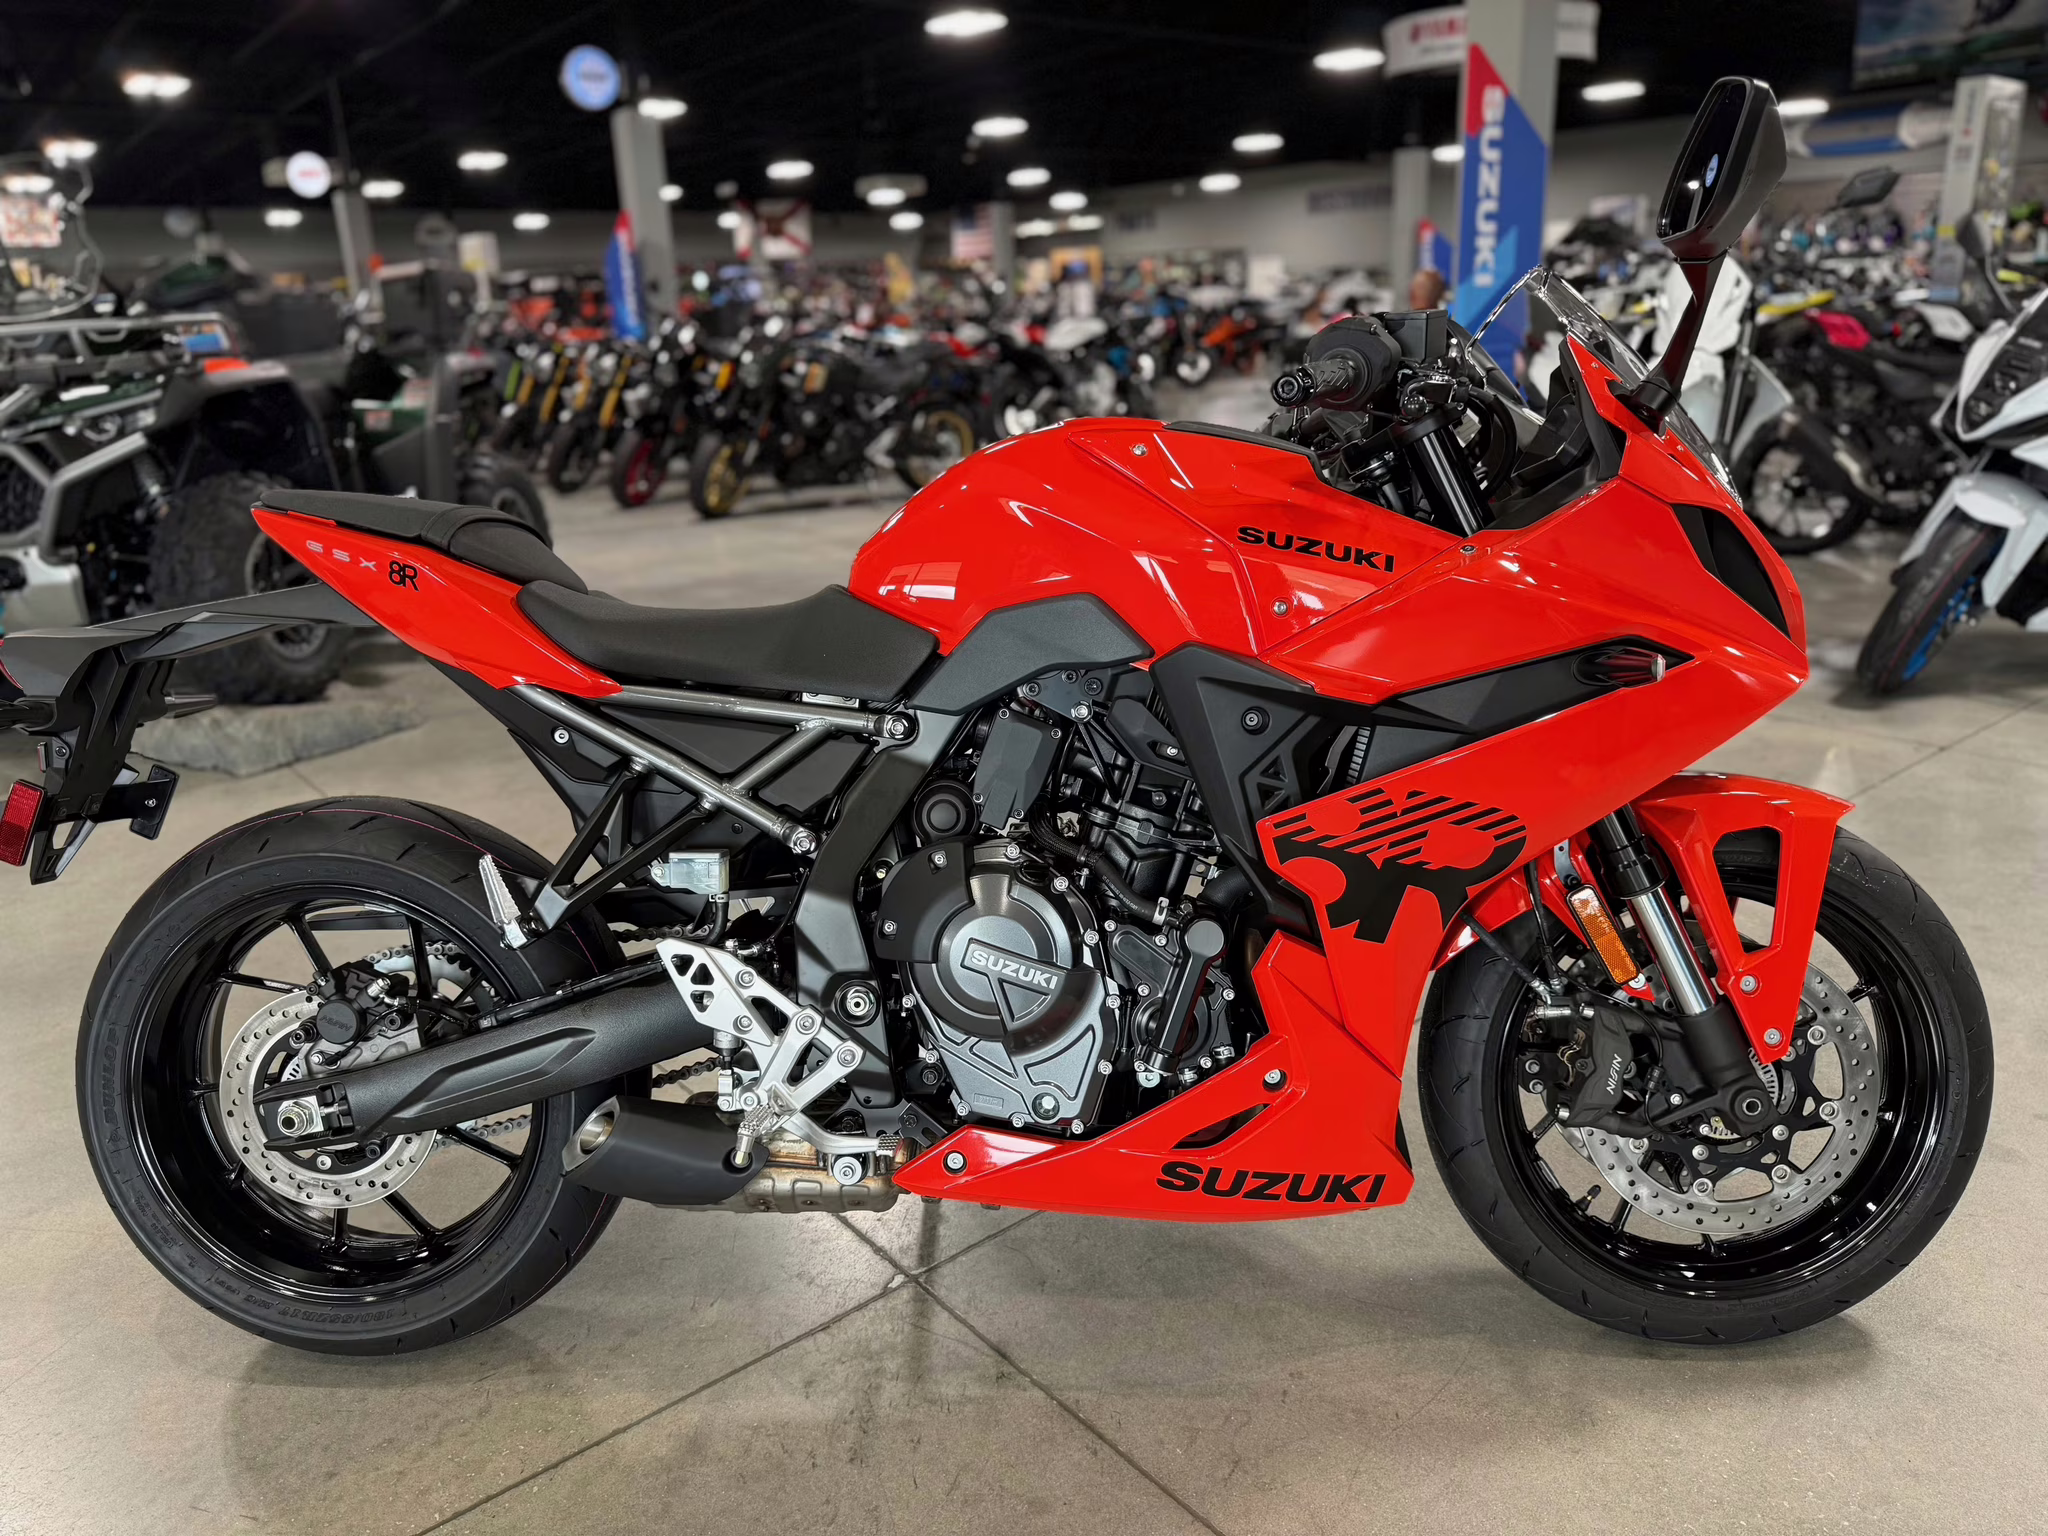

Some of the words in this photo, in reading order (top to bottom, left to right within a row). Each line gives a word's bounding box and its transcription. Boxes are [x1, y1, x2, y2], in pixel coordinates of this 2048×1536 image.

[1472, 84, 1506, 288] SUZUKI
[1236, 526, 1395, 573] SUZUKI
[388, 560, 419, 592] 8R
[970, 949, 1059, 990] SUZUKI
[101, 1026, 120, 1127] DUNLOP
[1606, 1053, 1623, 1096] NISSIN
[1155, 1160, 1387, 1204] SUZUKI
